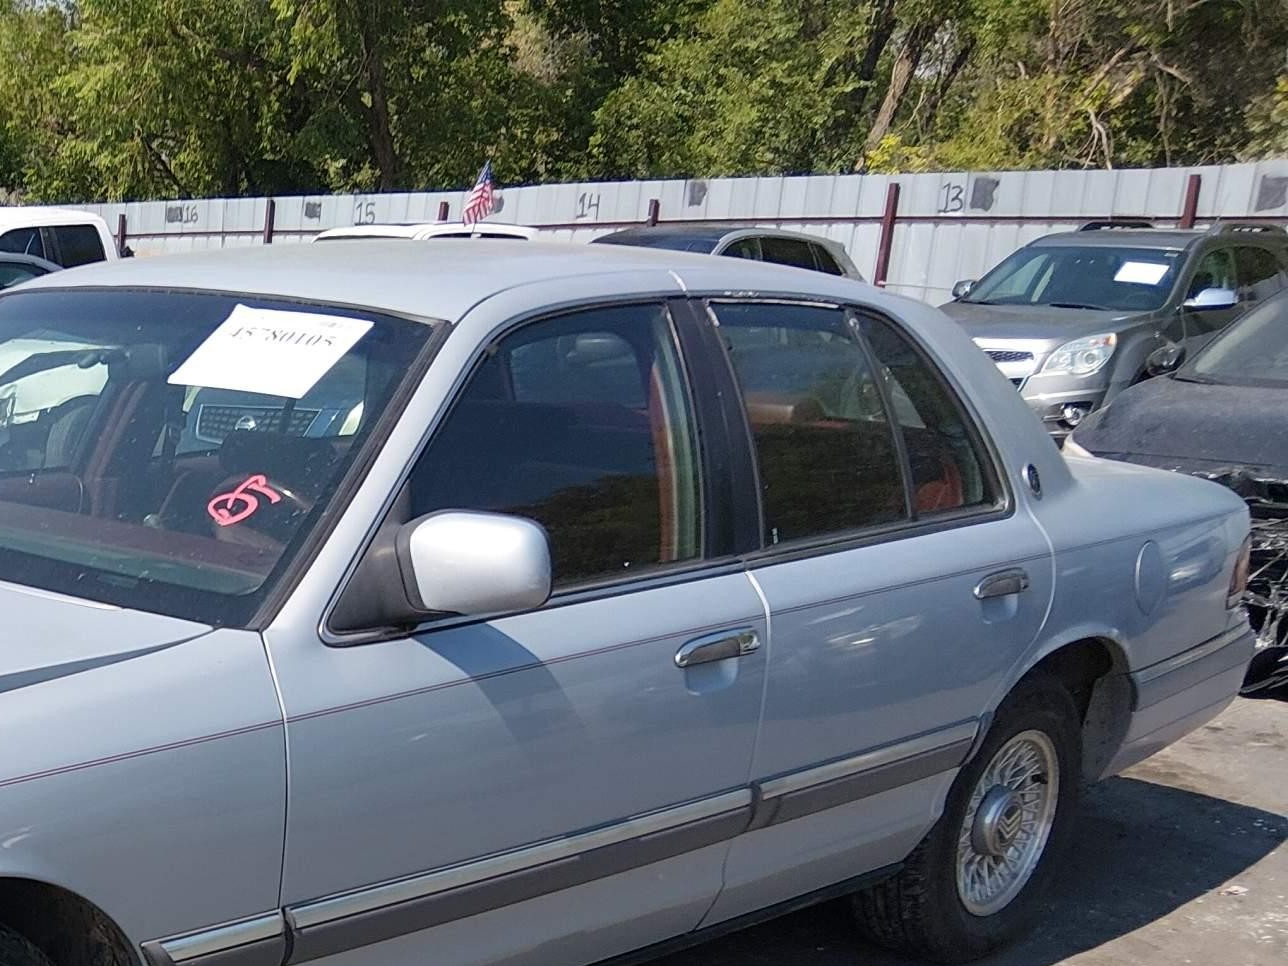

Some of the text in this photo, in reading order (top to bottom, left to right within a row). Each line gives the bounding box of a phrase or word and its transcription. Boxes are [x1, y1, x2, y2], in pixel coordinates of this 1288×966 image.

[575, 192, 600, 220] 14
[939, 182, 964, 213] 13
[183, 205, 198, 223] 16
[354, 202, 376, 225] 15
